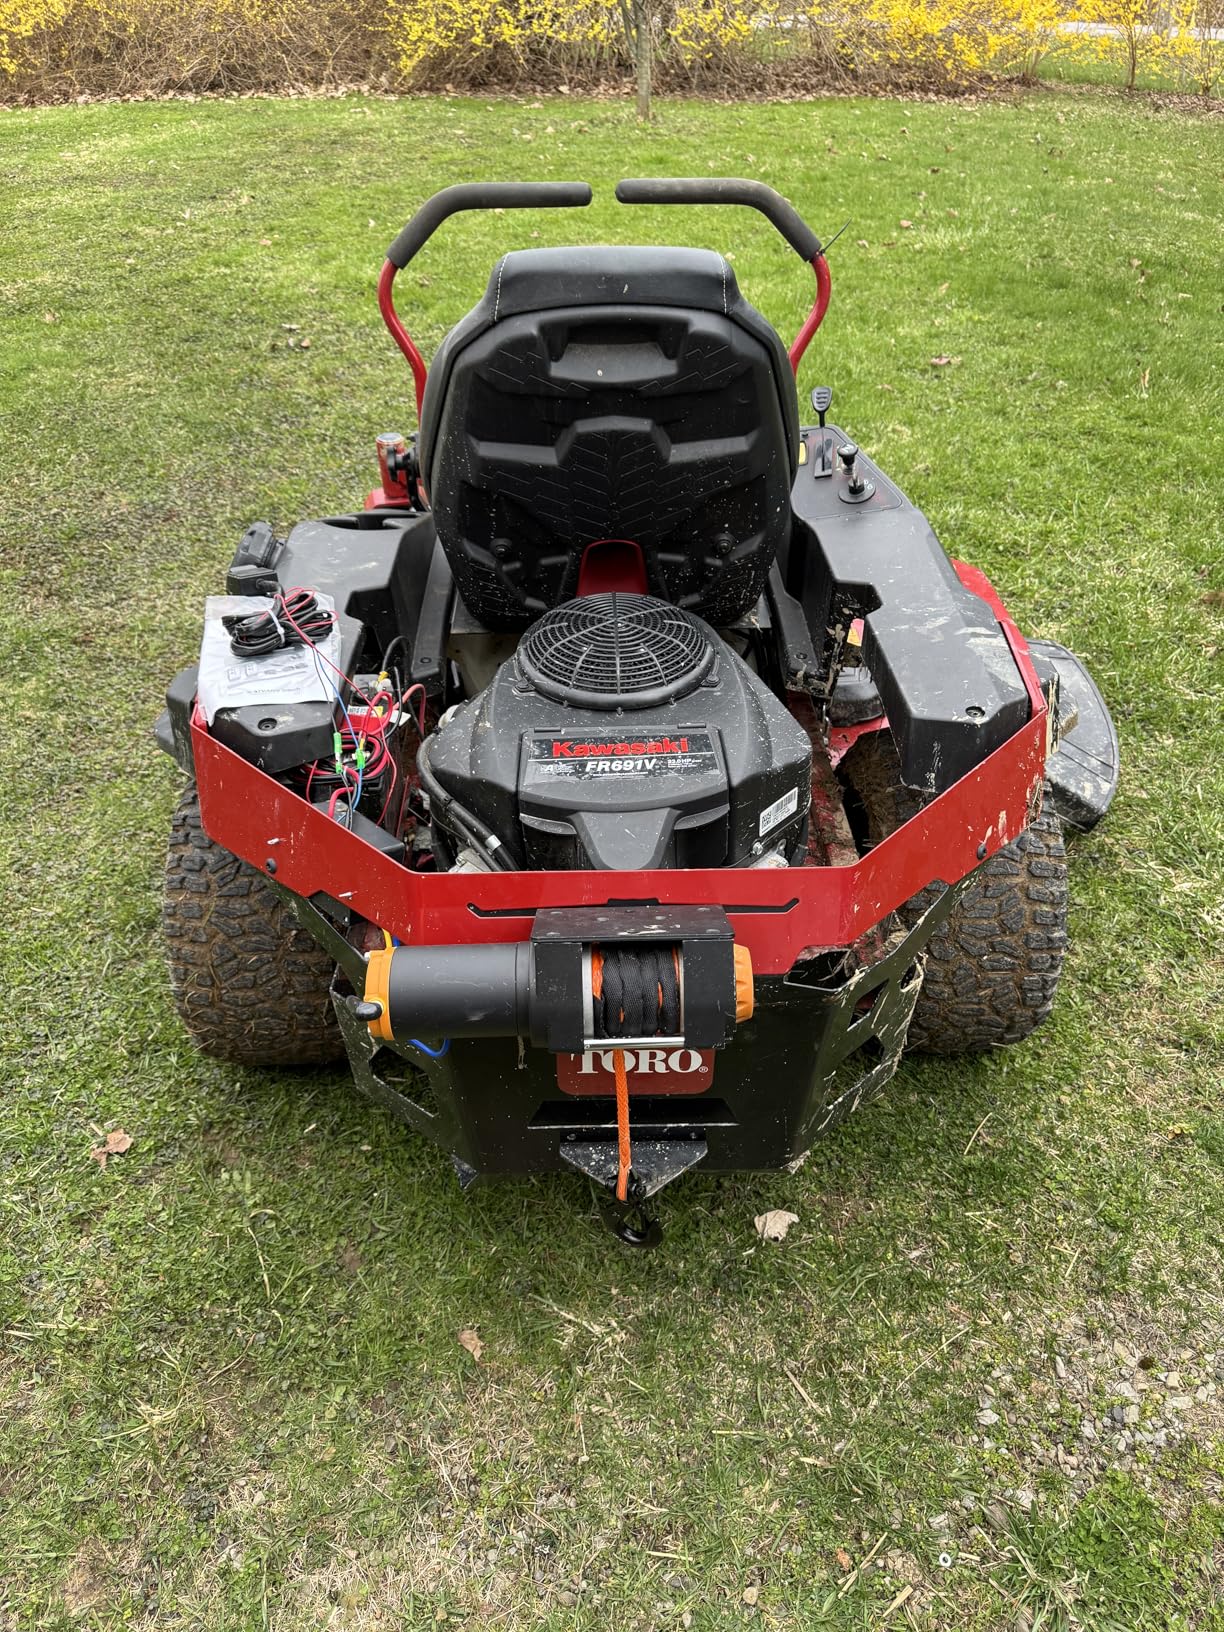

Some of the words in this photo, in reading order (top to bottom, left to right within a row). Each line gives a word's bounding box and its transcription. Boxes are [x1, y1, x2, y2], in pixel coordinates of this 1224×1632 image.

[553, 737, 689, 757] Kawasaki
[585, 758, 657, 772] FR691V
[570, 1049, 703, 1074] TORO
